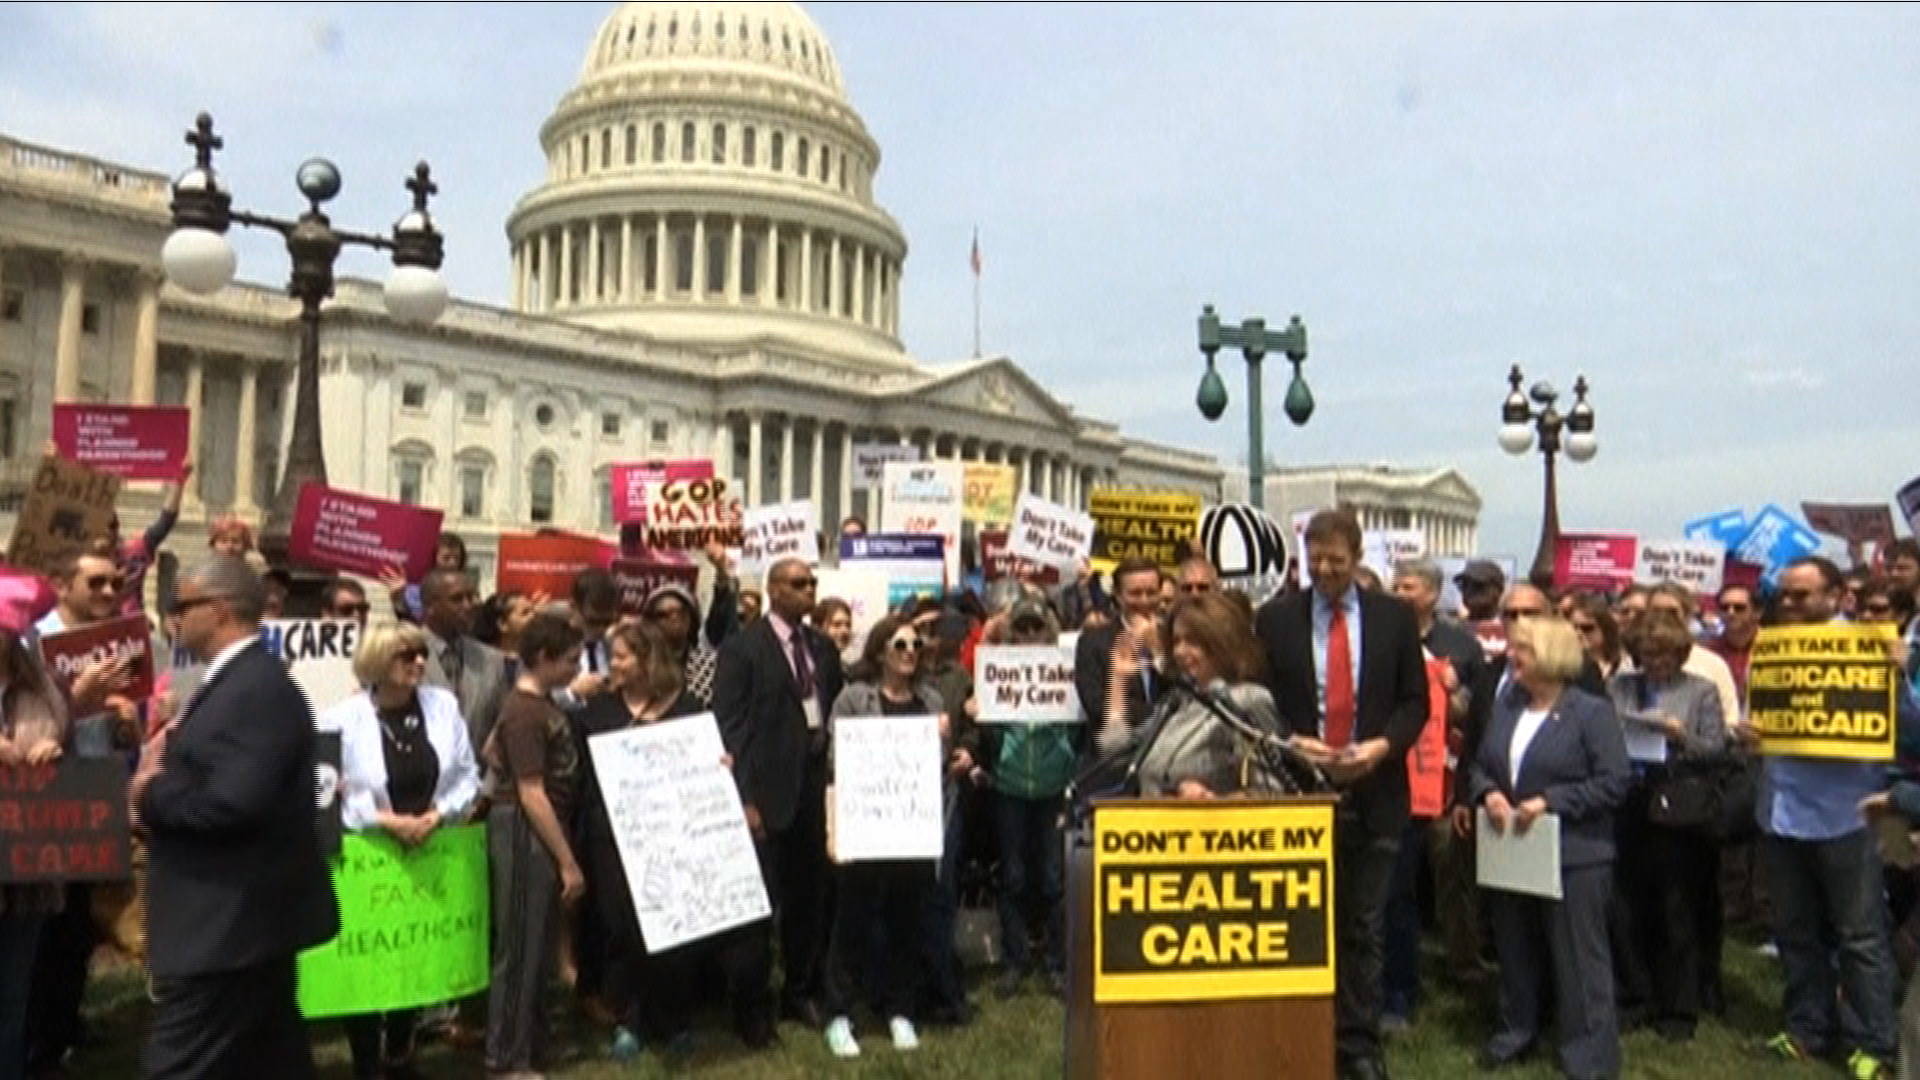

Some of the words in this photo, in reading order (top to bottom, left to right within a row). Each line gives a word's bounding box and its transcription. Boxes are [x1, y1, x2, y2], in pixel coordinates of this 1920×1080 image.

[659, 478, 727, 504] GOP
[653, 498, 744, 524] HATES
[771, 516, 806, 535] Take
[1022, 508, 1057, 532] Don't
[1059, 520, 1087, 544] Take
[766, 538, 800, 557] Care
[1025, 526, 1046, 551] My
[1047, 536, 1076, 557] Care
[1107, 540, 1175, 564] CARE
[1643, 547, 1680, 563] Don't
[1799, 638, 1849, 653] TAKE
[985, 662, 1033, 683] Don't
[1752, 665, 1889, 690] MEDICARE
[996, 684, 1023, 709] My
[1026, 684, 1067, 705] Care
[1791, 690, 1824, 707] and
[1752, 710, 1888, 738] MEDICAID
[1102, 829, 1193, 853] DON'T
[1200, 828, 1275, 851] TAKE
[1283, 827, 1325, 849] MY
[1106, 868, 1322, 914] HEALTH
[1141, 921, 1289, 966] CARE
